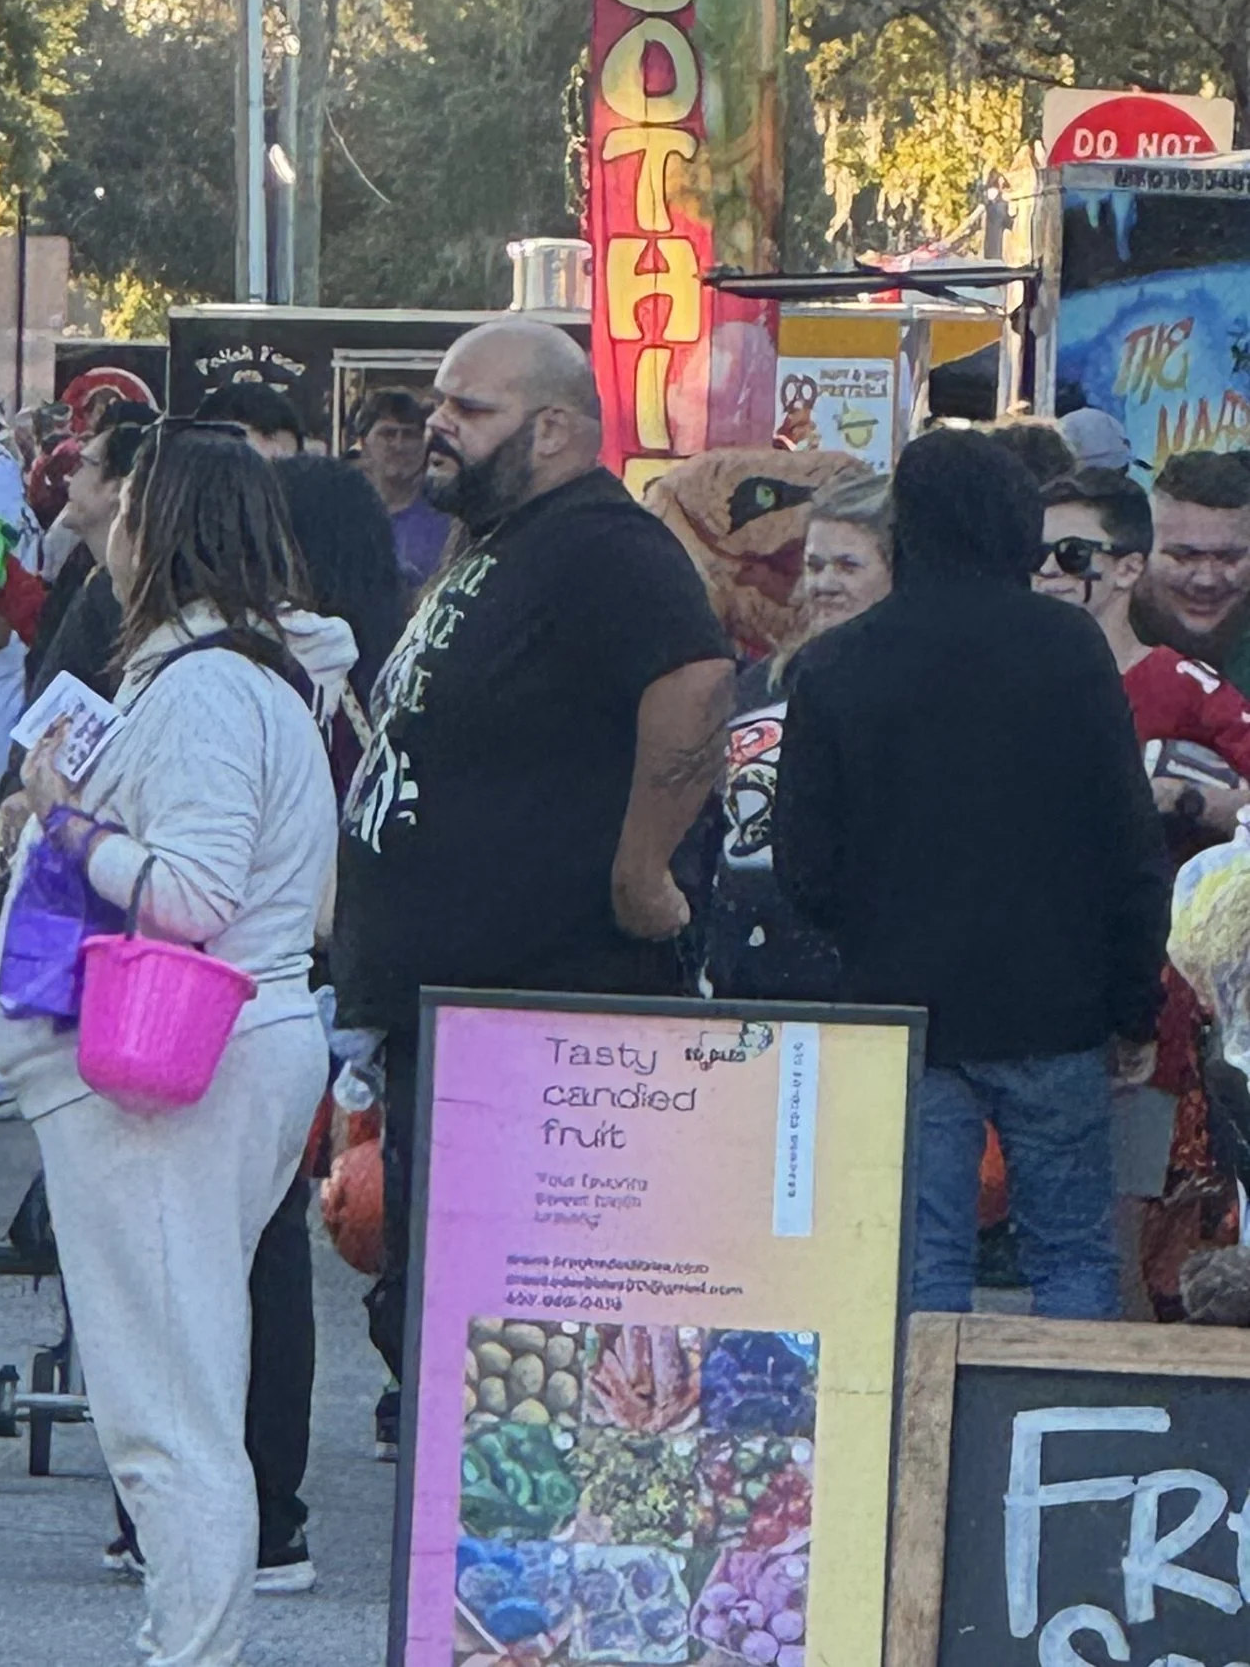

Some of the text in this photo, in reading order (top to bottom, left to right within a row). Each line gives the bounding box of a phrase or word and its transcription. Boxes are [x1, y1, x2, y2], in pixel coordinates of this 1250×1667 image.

[1073, 128, 1201, 158] DO NOT
[546, 1036, 657, 1075] Tasty
[543, 1083, 697, 1112] candied
[541, 1118, 627, 1149] fruit
[1003, 1405, 1250, 1639] FR
